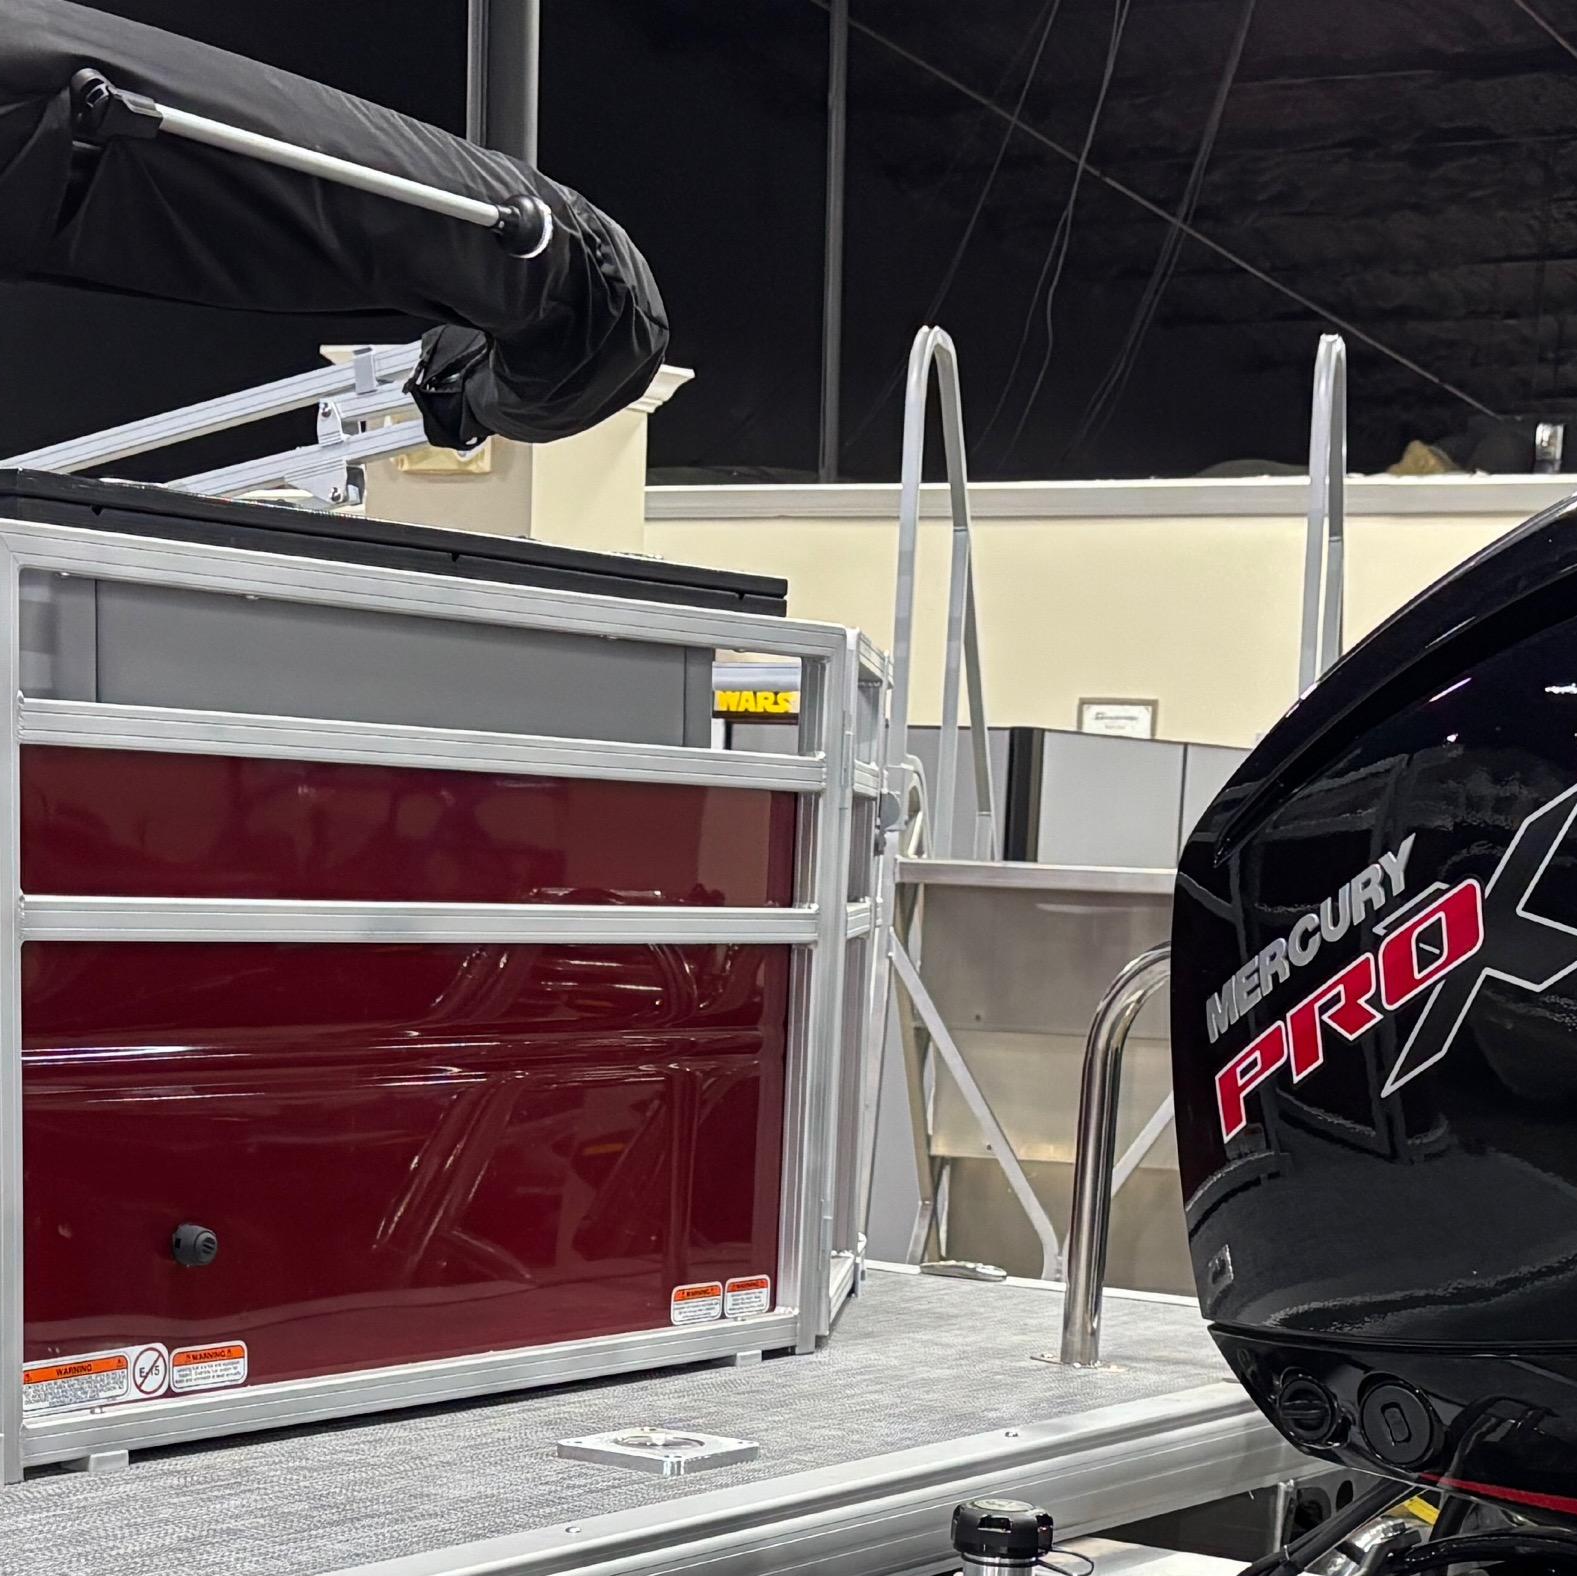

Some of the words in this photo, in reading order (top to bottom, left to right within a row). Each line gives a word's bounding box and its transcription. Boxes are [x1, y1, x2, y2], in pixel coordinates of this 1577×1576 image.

[715, 690, 793, 713] WARS
[1205, 832, 1416, 1044] MERCURY
[1215, 878, 1485, 1144] PRO
[191, 1350, 226, 1361] WARNING
[56, 1364, 92, 1377] WARNING
